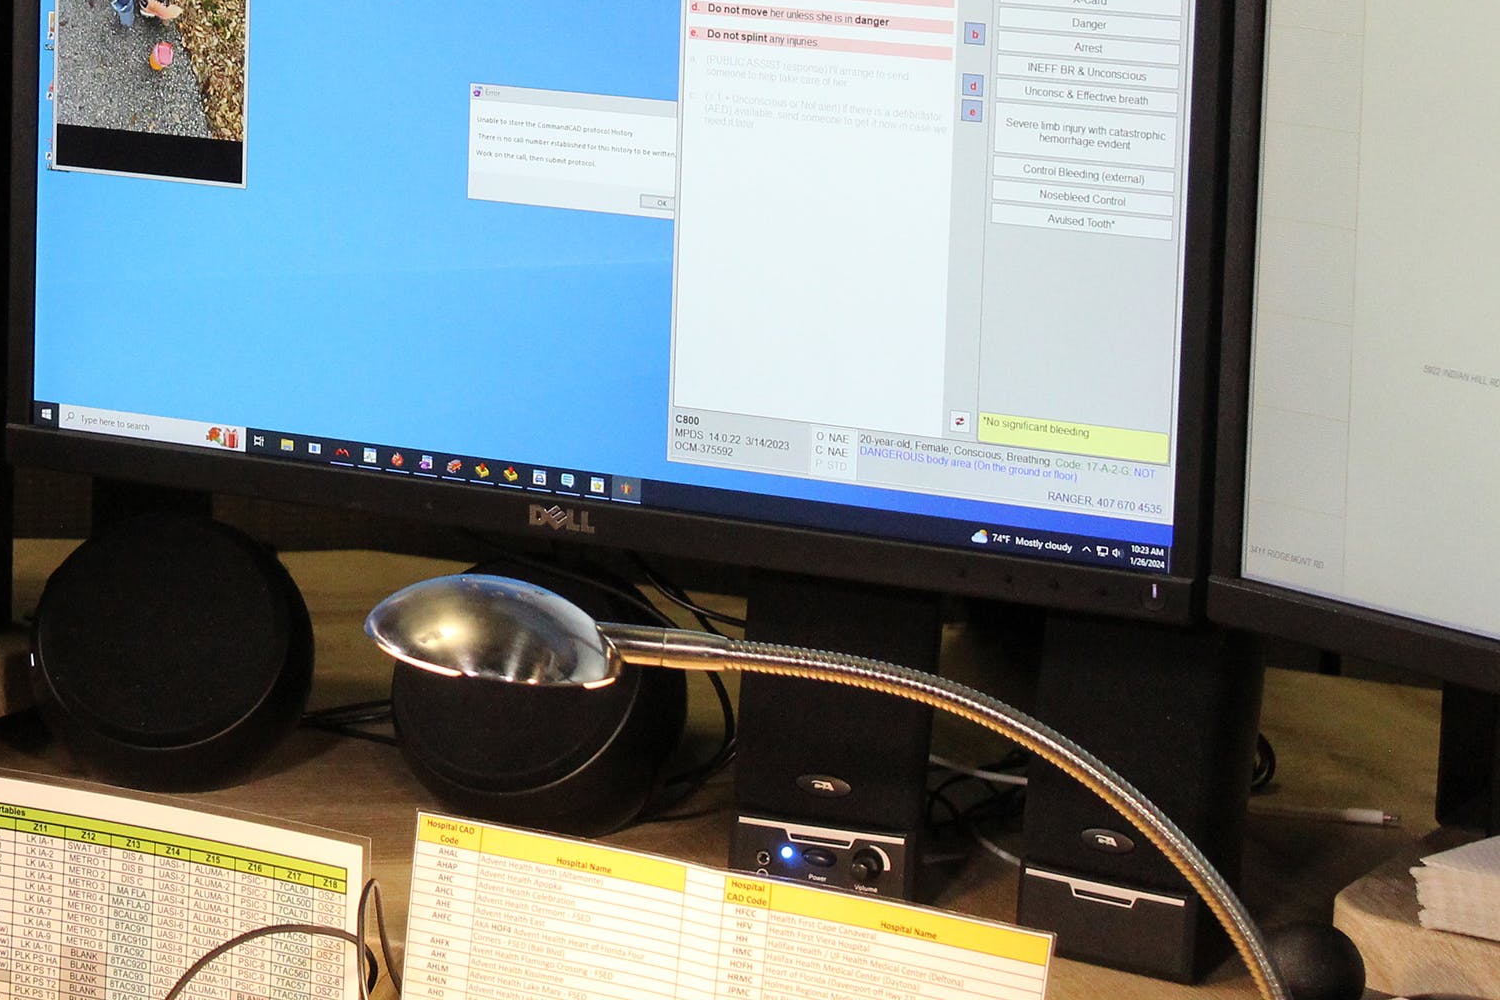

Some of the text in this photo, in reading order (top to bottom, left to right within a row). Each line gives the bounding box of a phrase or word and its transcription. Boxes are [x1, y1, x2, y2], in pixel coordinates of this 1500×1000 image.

[708, 3, 889, 27] Do not move her unless she is in danger
[1072, 18, 1107, 31] Danger
[1074, 42, 1102, 53] Arrest
[675, 414, 699, 426] C800
[530, 504, 595, 535] DELL
[427, 819, 475, 834] Hospital CAD
[127, 839, 141, 848] Z13
[440, 836, 459, 846] Code
[880, 920, 937, 940] Hospital Name
